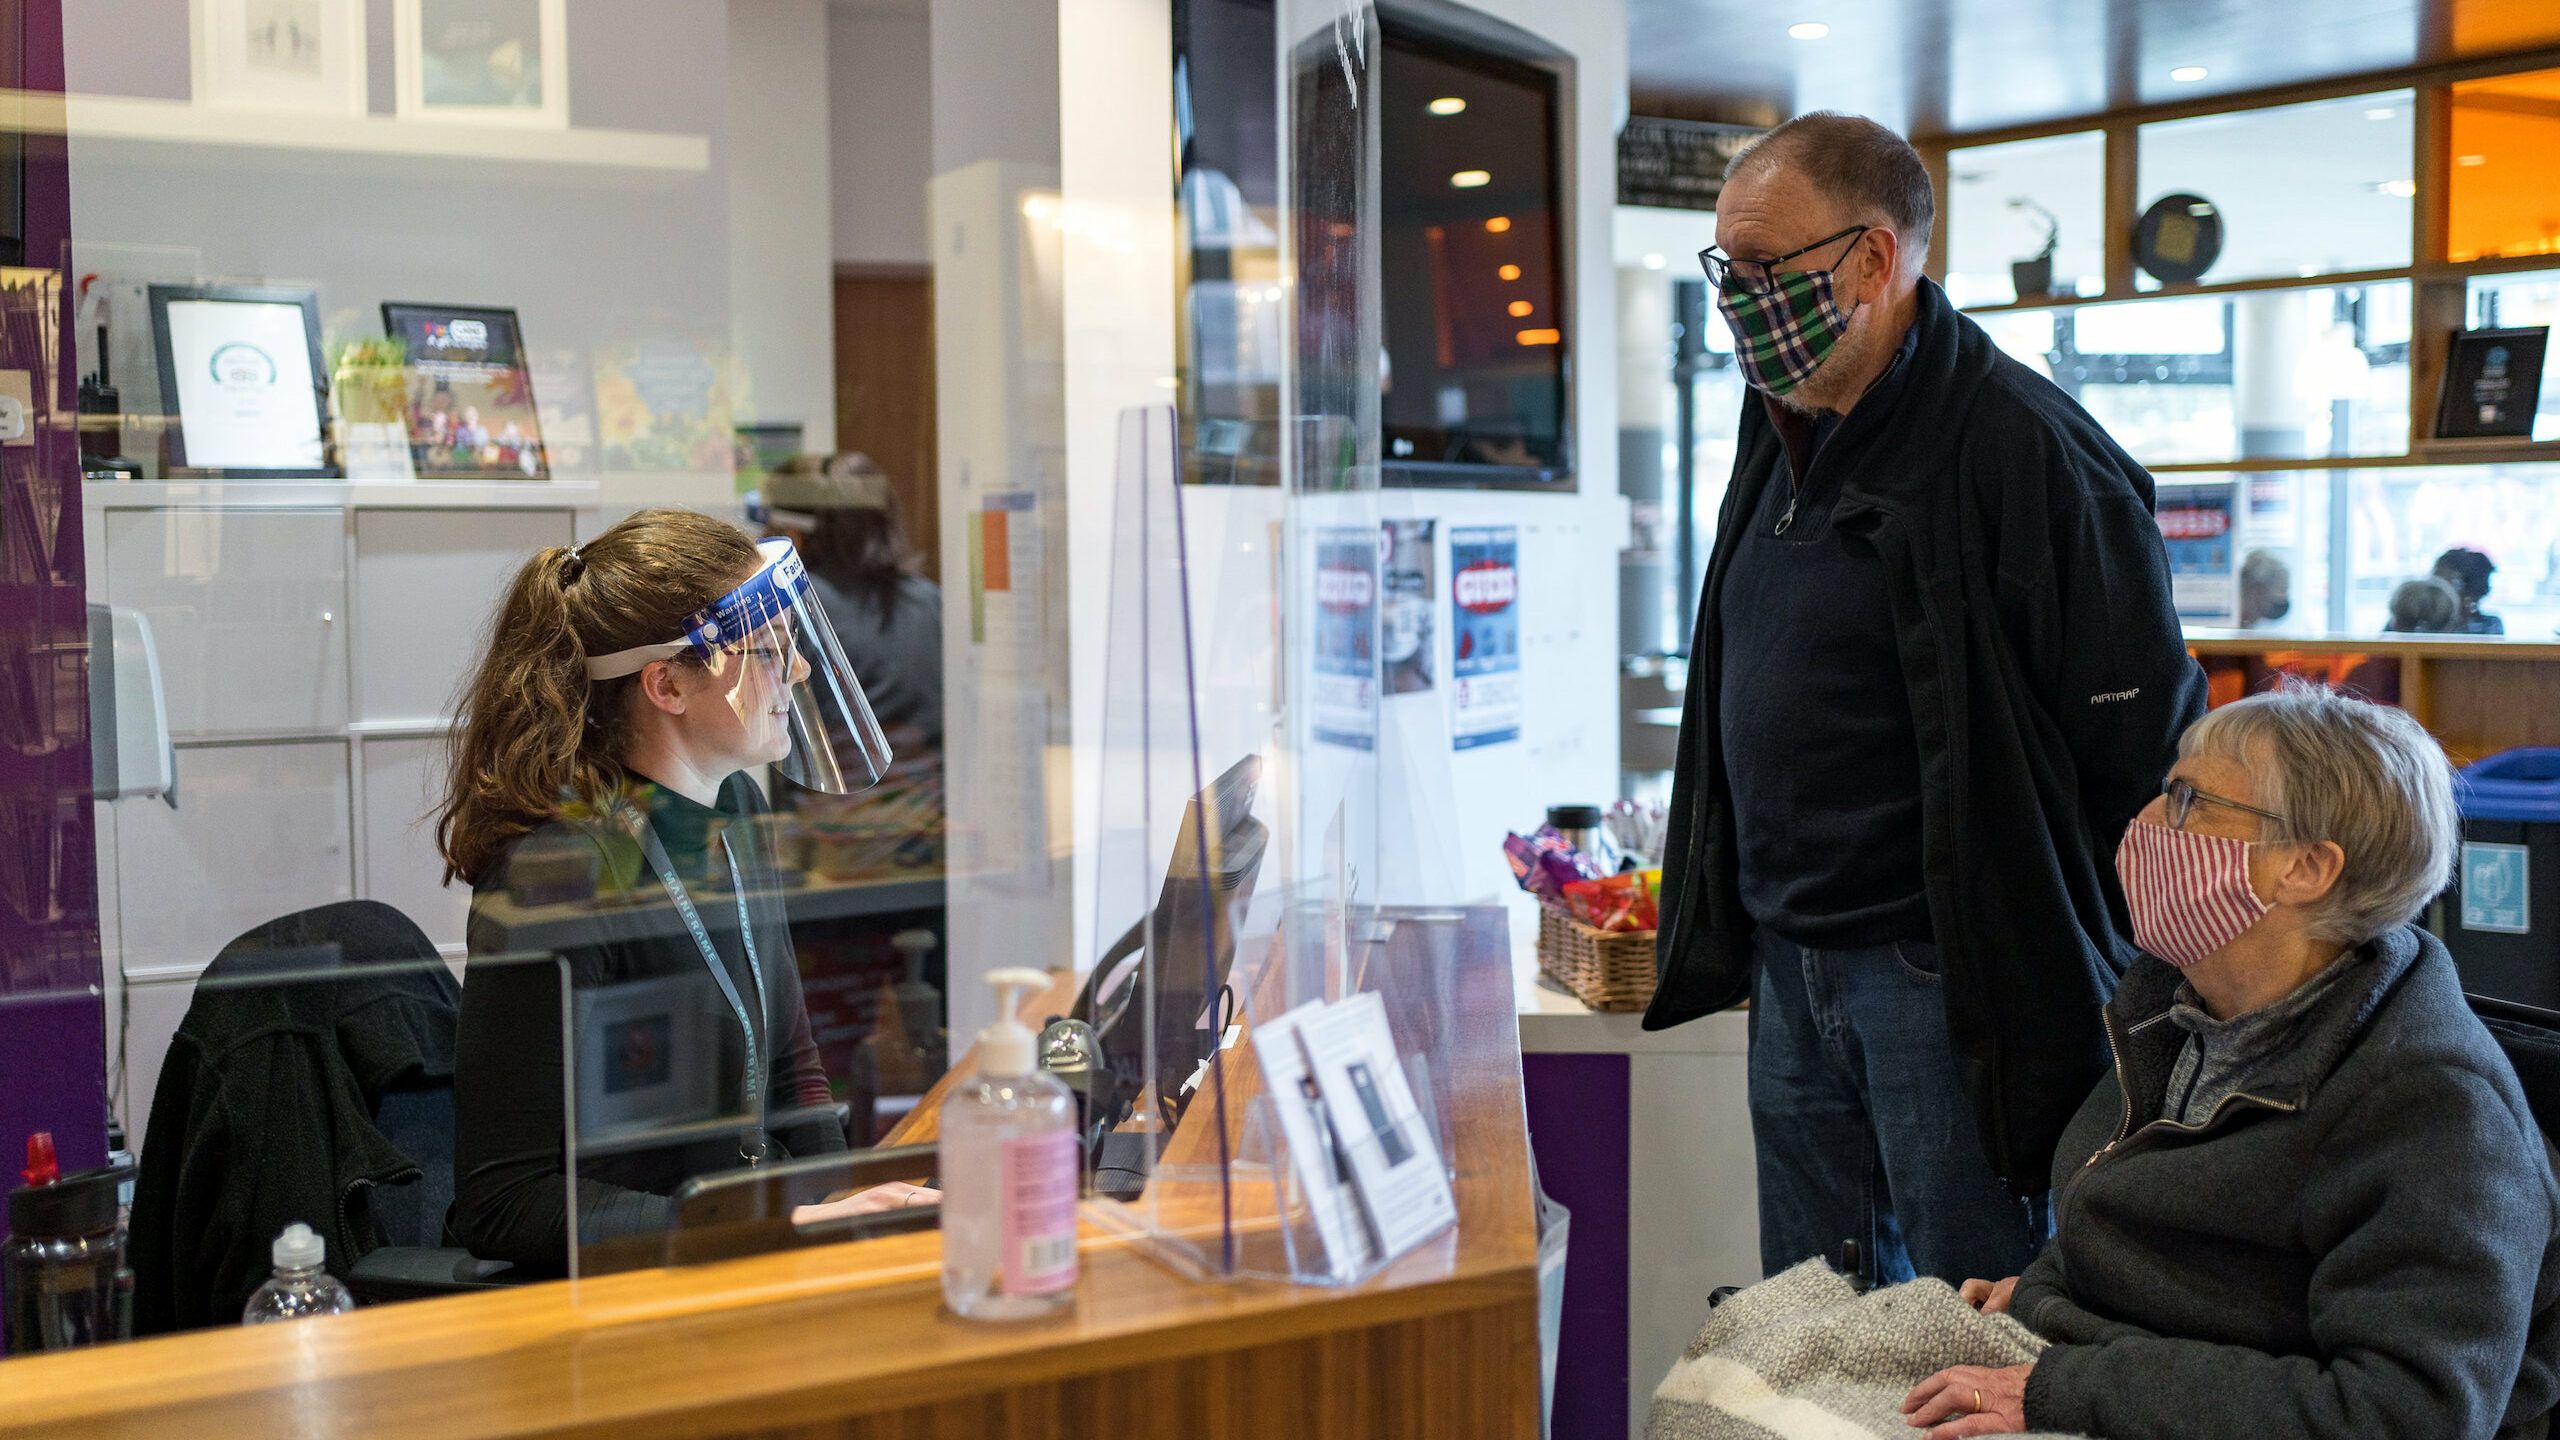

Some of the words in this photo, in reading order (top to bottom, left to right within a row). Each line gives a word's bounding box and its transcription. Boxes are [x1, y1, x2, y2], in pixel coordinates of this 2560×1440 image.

[716, 593, 755, 619] Warning:
[2091, 687, 2140, 704] AIRTRAP
[663, 871, 717, 962] MAINFRAME
[737, 1005, 756, 1101] MAINFRAME
